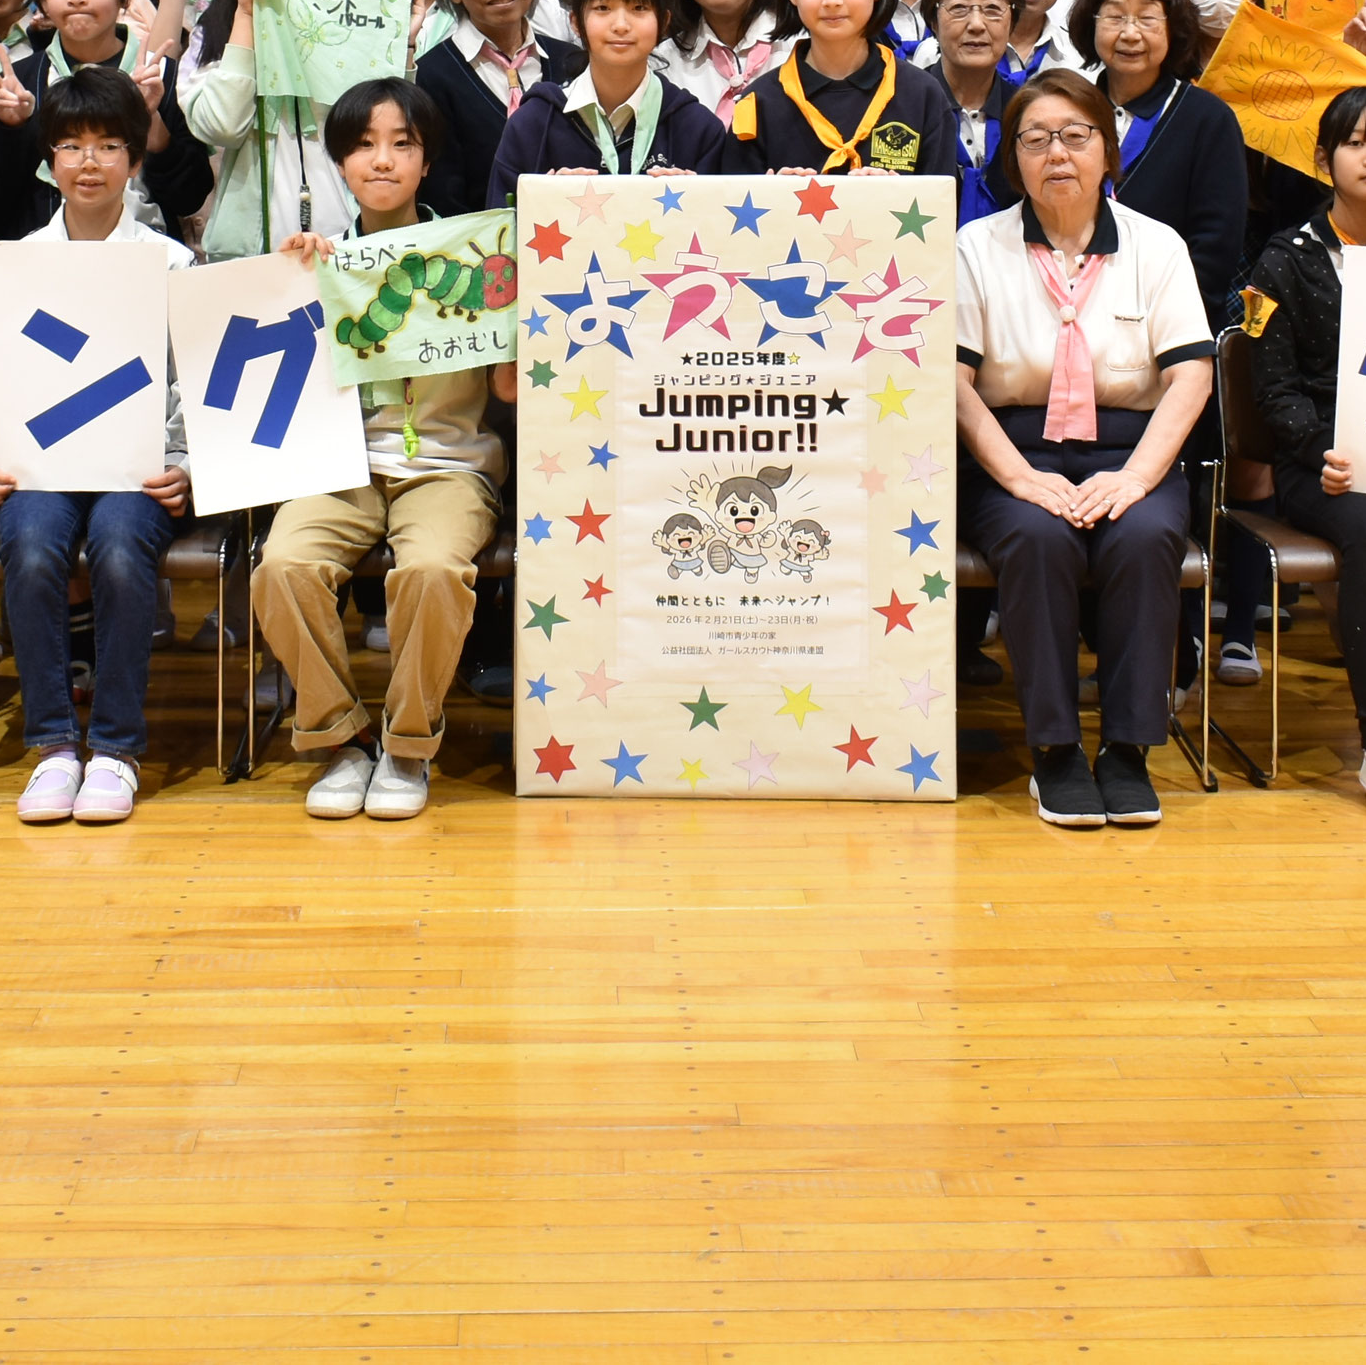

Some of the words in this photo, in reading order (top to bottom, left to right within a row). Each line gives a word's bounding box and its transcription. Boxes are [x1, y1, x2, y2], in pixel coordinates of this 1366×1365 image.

[563, 251, 933, 353] ようこそ
[418, 331, 508, 363] あおむし
[656, 595, 726, 607] 仲間とともに
